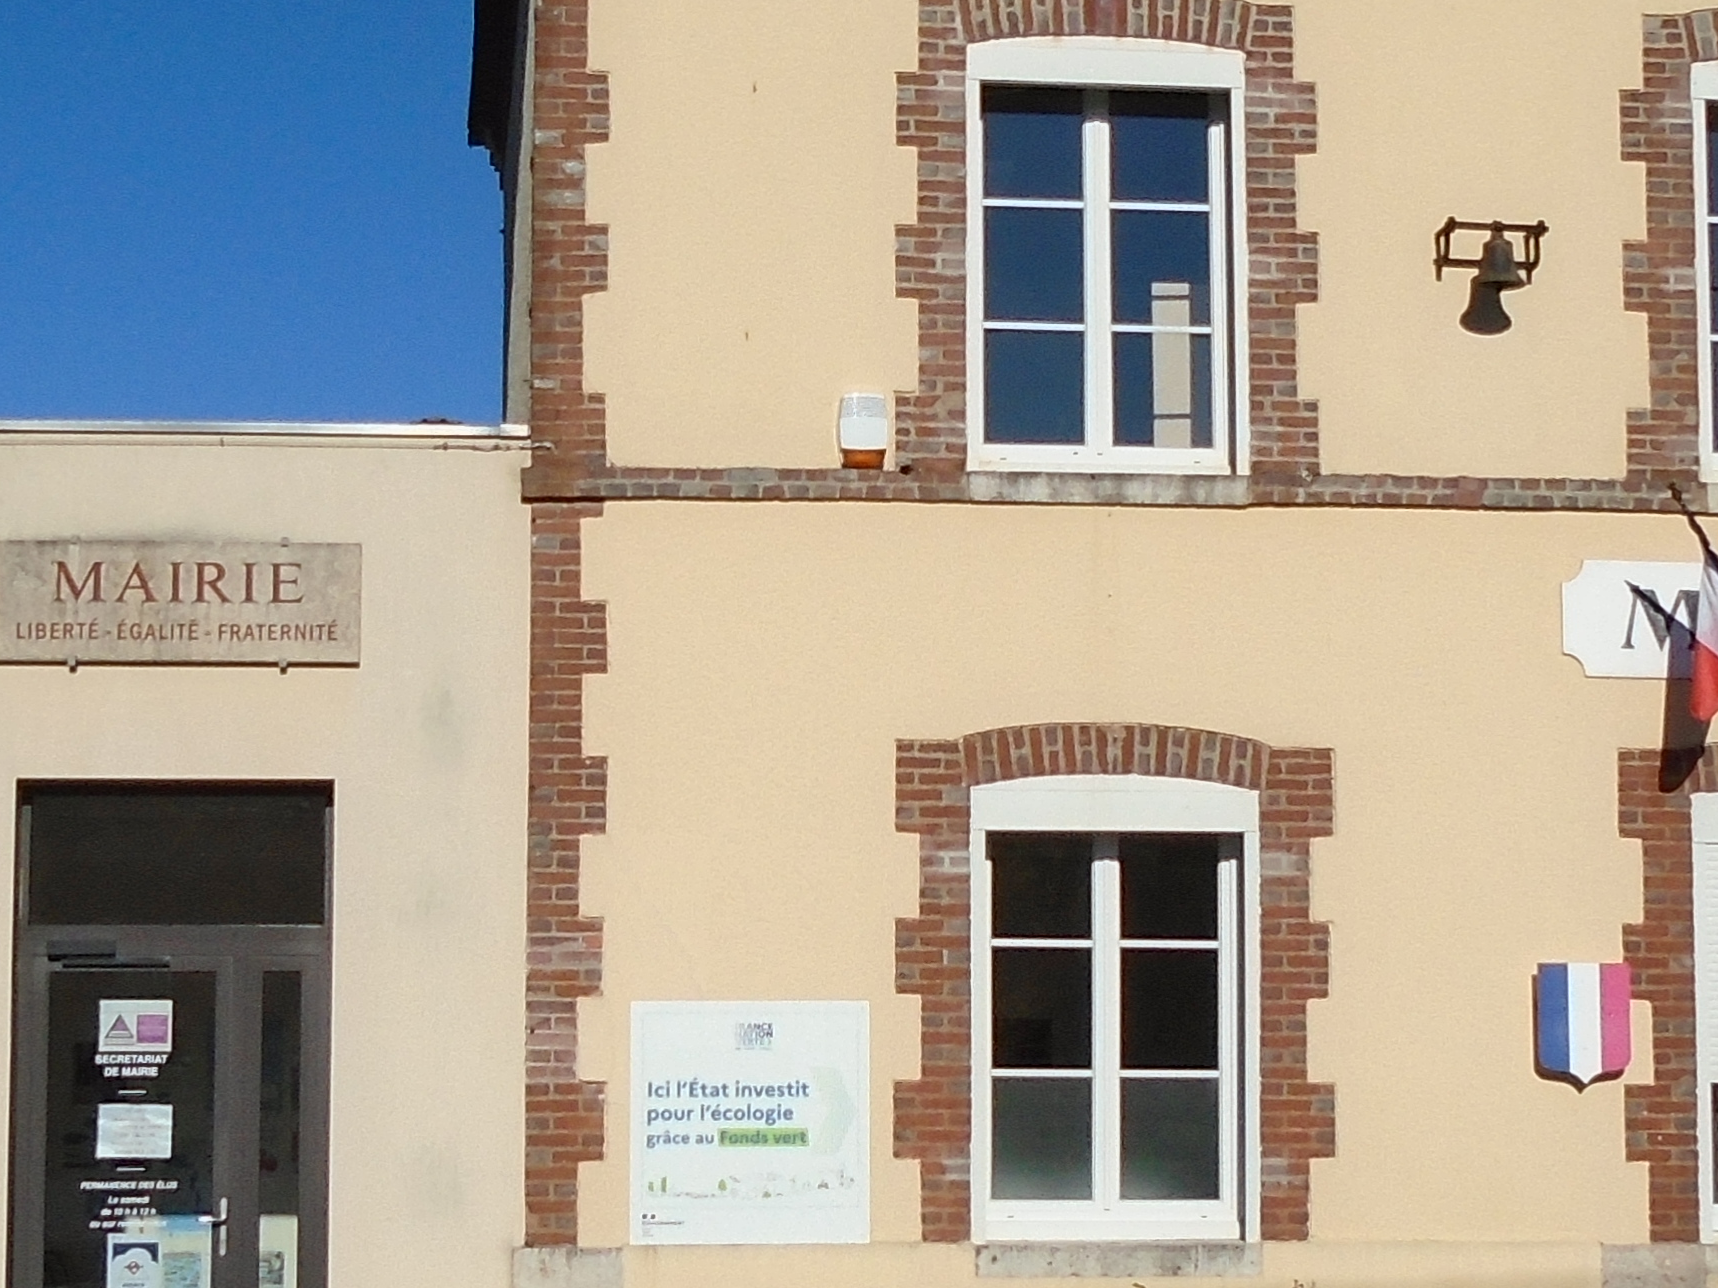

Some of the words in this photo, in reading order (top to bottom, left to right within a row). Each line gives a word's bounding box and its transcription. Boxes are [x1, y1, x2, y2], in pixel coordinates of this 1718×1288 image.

[52, 560, 304, 604] MAIRIE
[16, 618, 100, 640] LIBERTÉ
[117, 618, 199, 640] ÉGALITÉ
[218, 618, 339, 641] FRATERNITÉ
[103, 1066, 120, 1077] DE
[121, 1066, 159, 1076] MAIRIE
[647, 1080, 671, 1098] Ici
[677, 1078, 729, 1098] l'État
[735, 1080, 810, 1098] investit
[647, 1108, 694, 1126] pour
[700, 1104, 794, 1126] l'écologie
[646, 1130, 690, 1148] grâce
[695, 1134, 715, 1145] au
[720, 1130, 768, 1145] Fonds
[773, 1131, 808, 1145] vert
